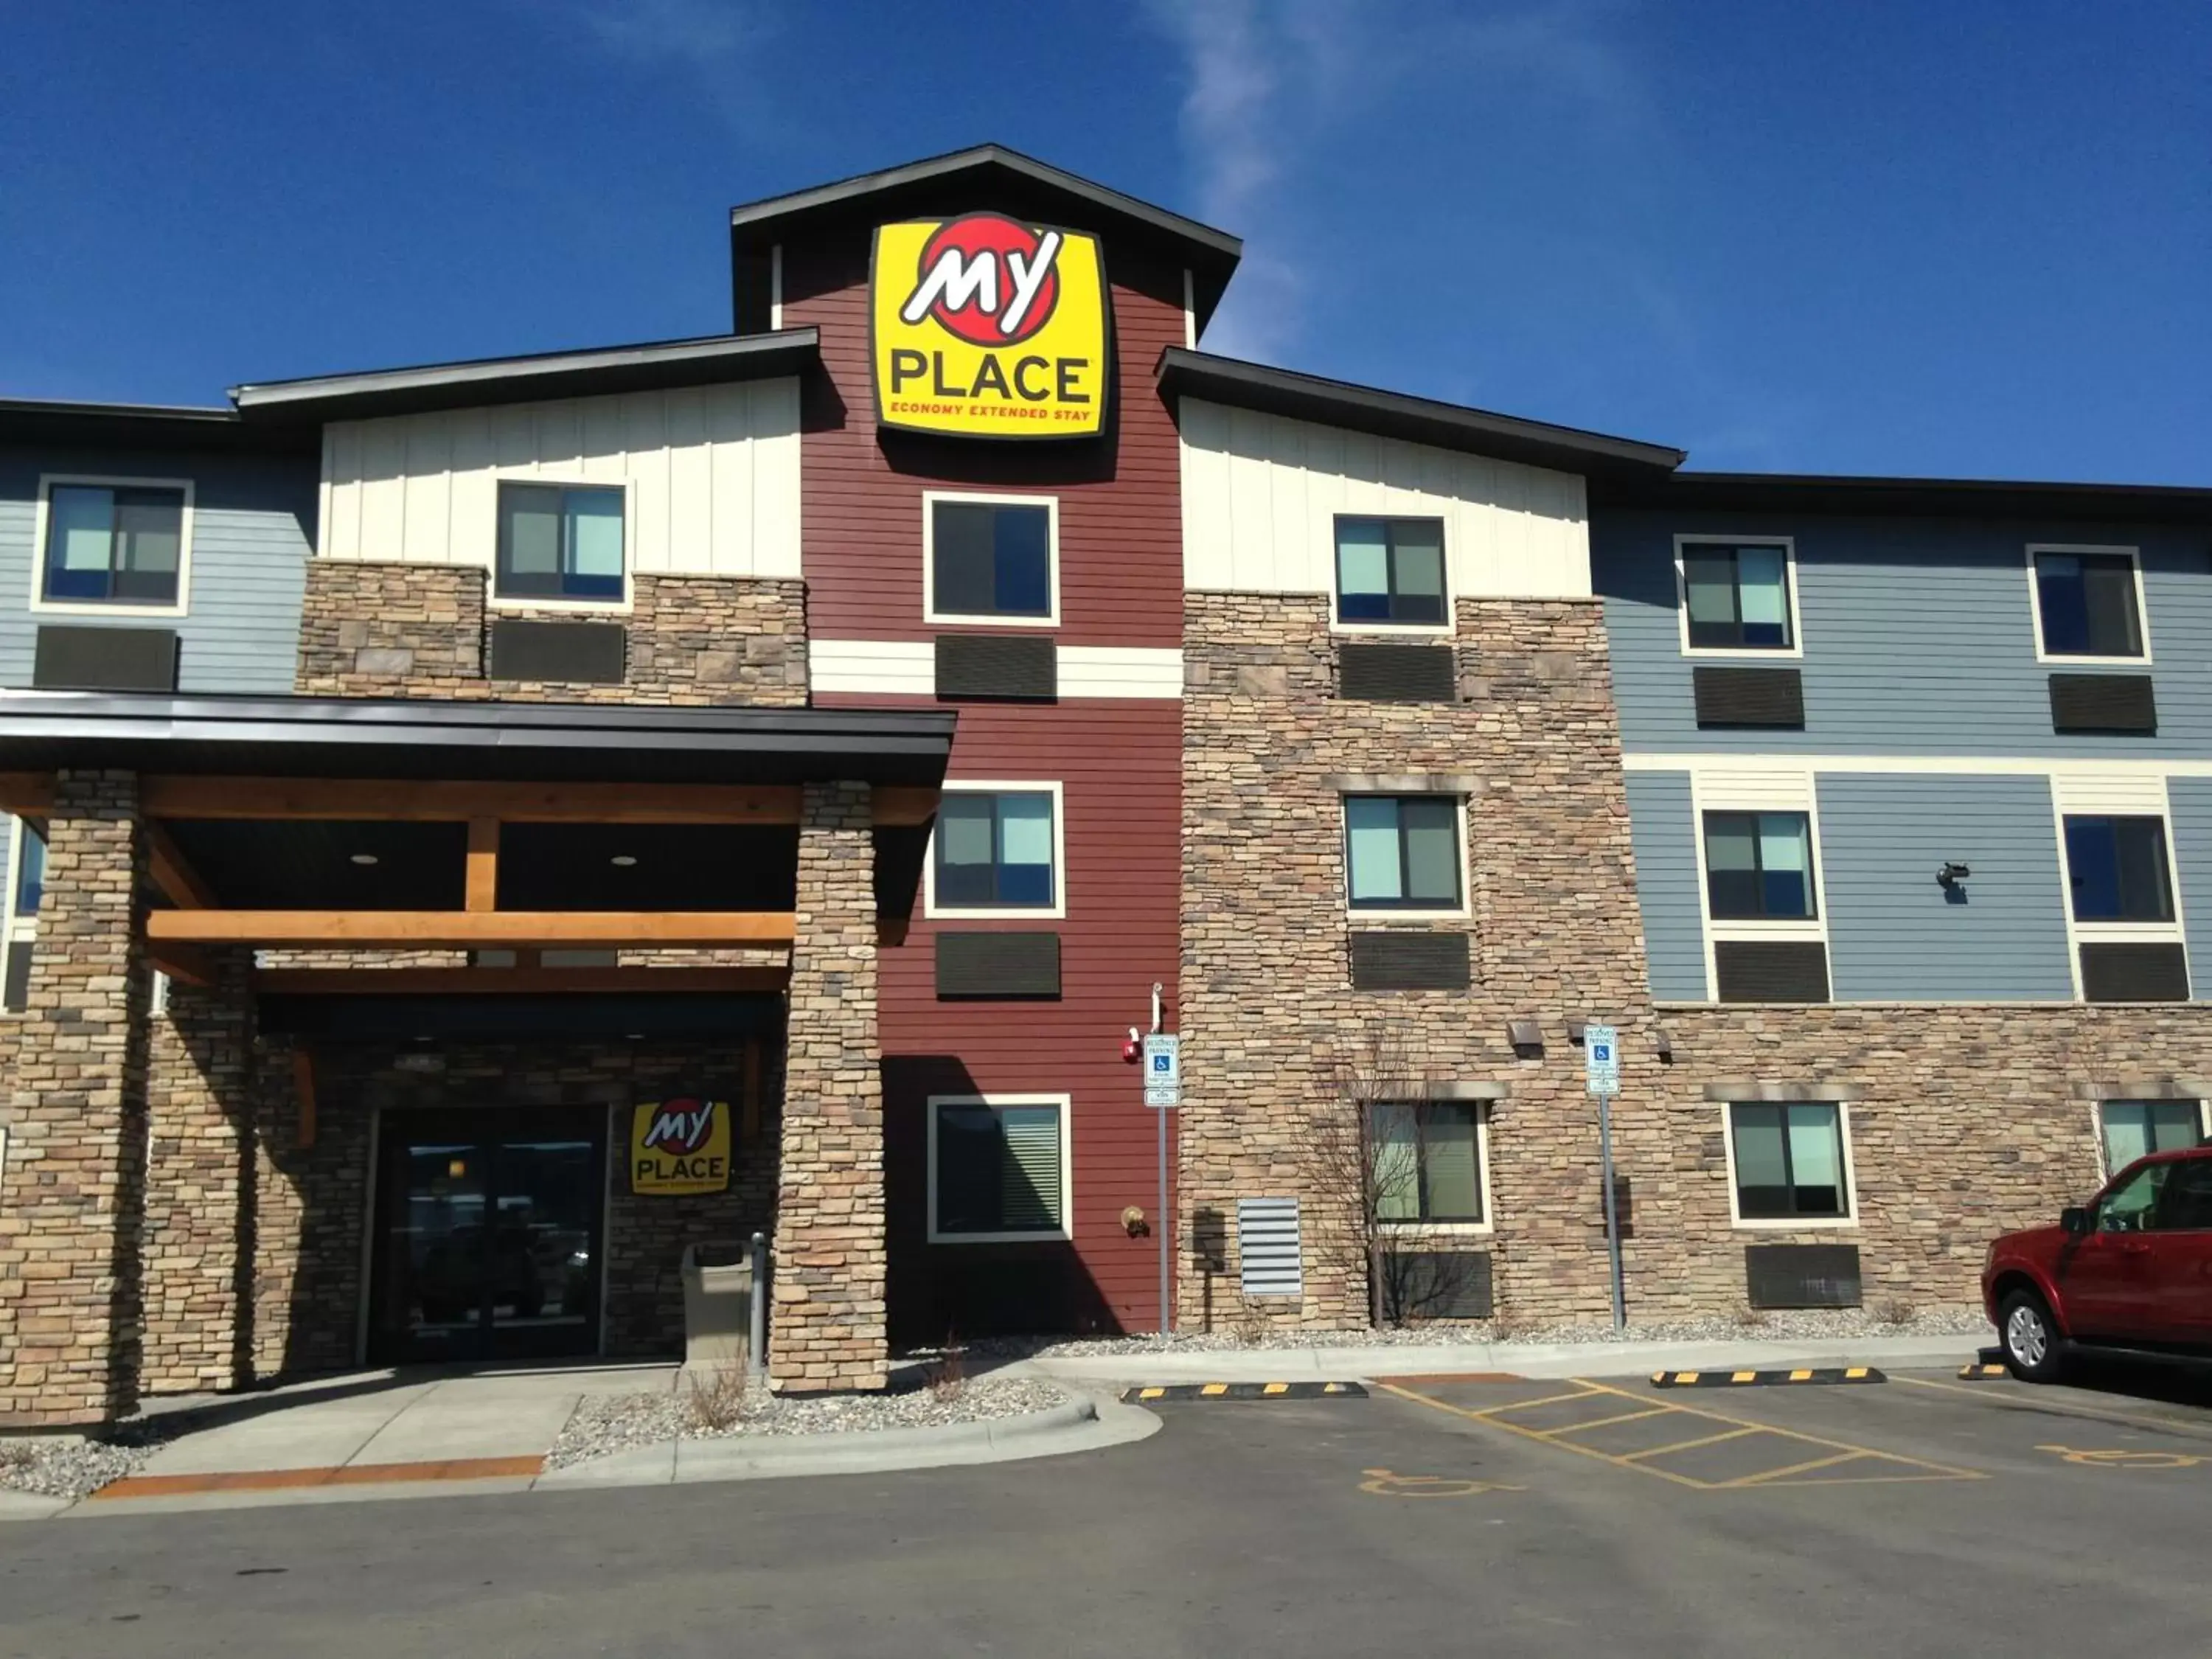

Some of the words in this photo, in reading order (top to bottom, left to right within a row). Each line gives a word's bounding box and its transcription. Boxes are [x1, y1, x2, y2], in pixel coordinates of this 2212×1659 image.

[890, 348, 1091, 404] PLACE
[890, 401, 964, 417] ECONOMY
[969, 406, 1048, 420] EXTENDED
[1053, 410, 1091, 422] STAY
[636, 1157, 724, 1181] PLACE
